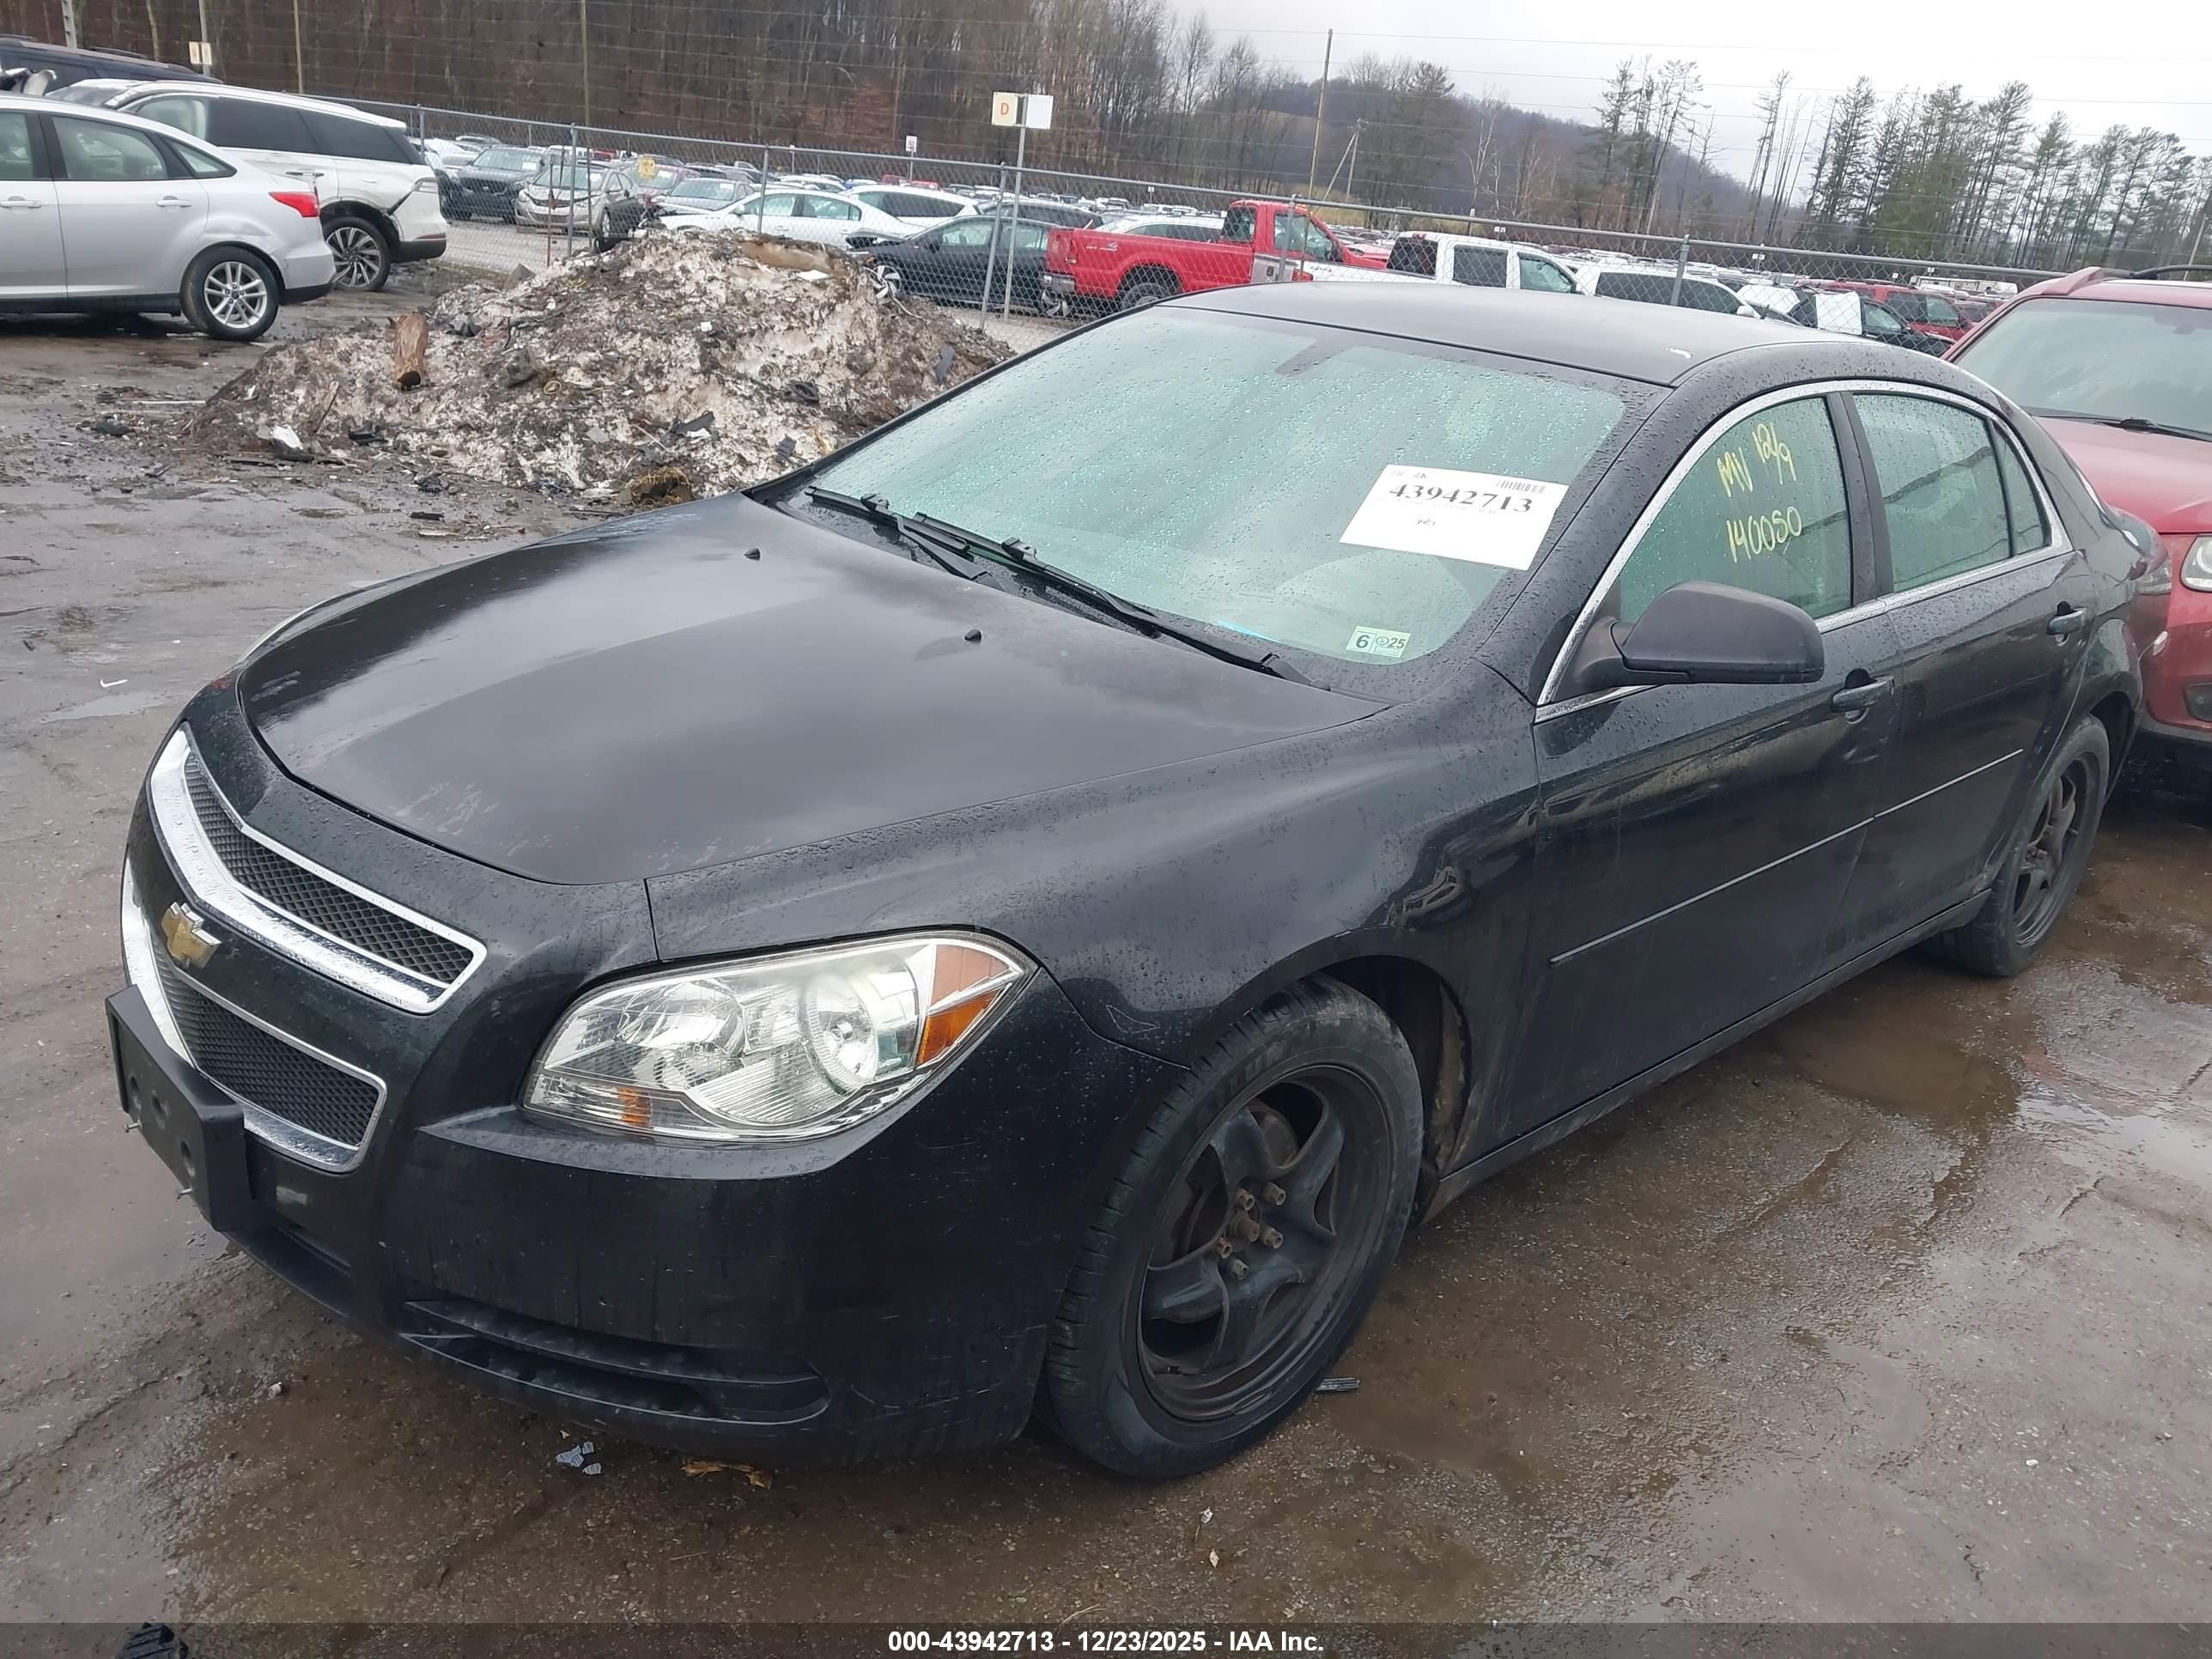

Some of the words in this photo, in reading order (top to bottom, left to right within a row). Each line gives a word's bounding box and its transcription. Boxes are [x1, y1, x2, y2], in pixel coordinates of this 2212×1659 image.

[1000, 102, 1009, 115] D
[1752, 422, 1797, 485] 12/9
[1389, 483, 1533, 513] 43942713
[1355, 634, 1371, 648] 6
[1387, 637, 1407, 649] 25
